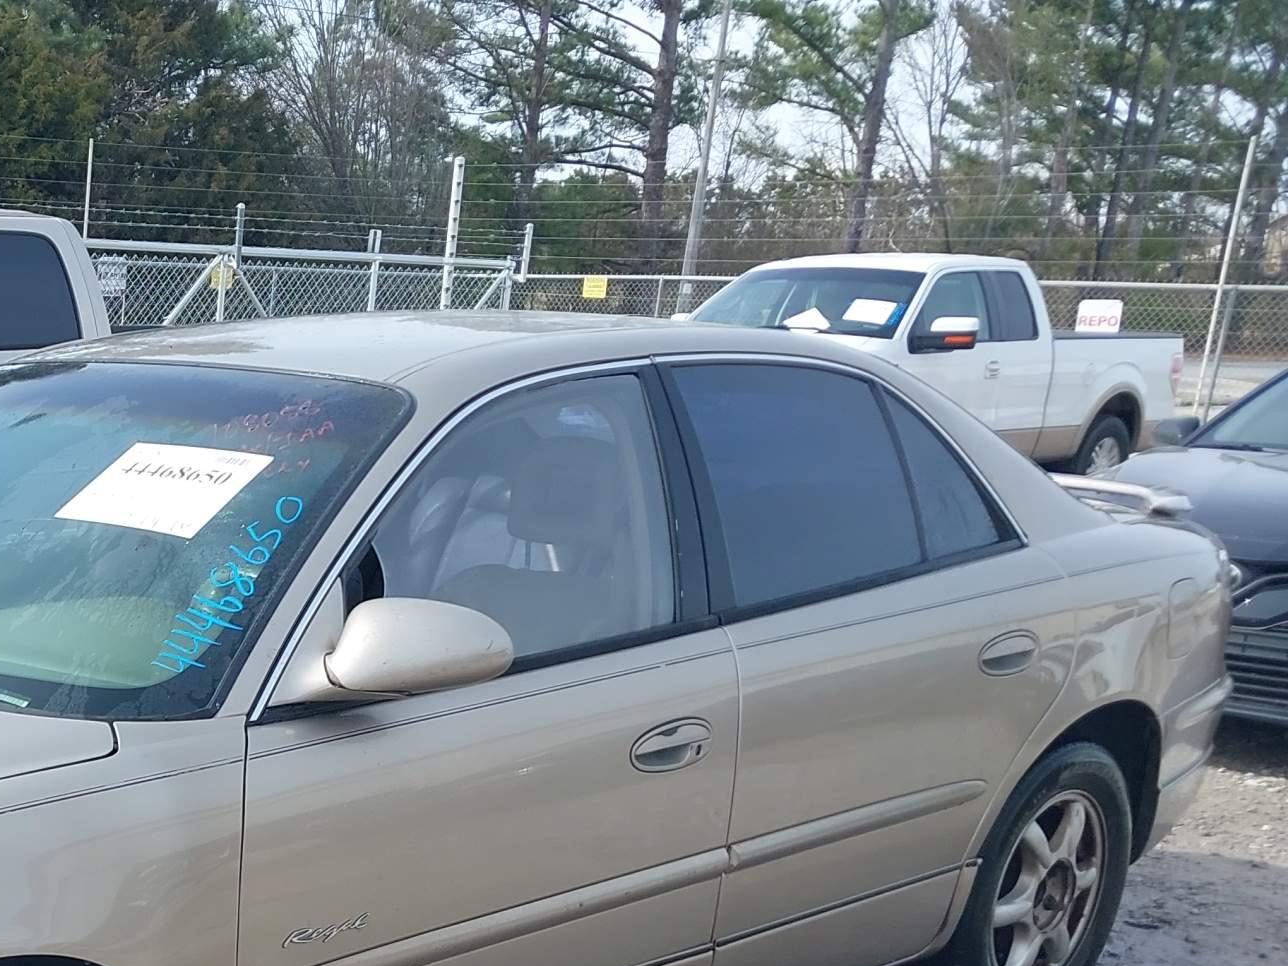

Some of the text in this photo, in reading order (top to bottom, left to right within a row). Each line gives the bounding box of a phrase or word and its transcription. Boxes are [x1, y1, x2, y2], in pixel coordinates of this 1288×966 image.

[1077, 314, 1120, 328] REPO
[120, 461, 233, 486] 44468650
[151, 495, 304, 674] 44468650
[281, 911, 371, 949] Regal
